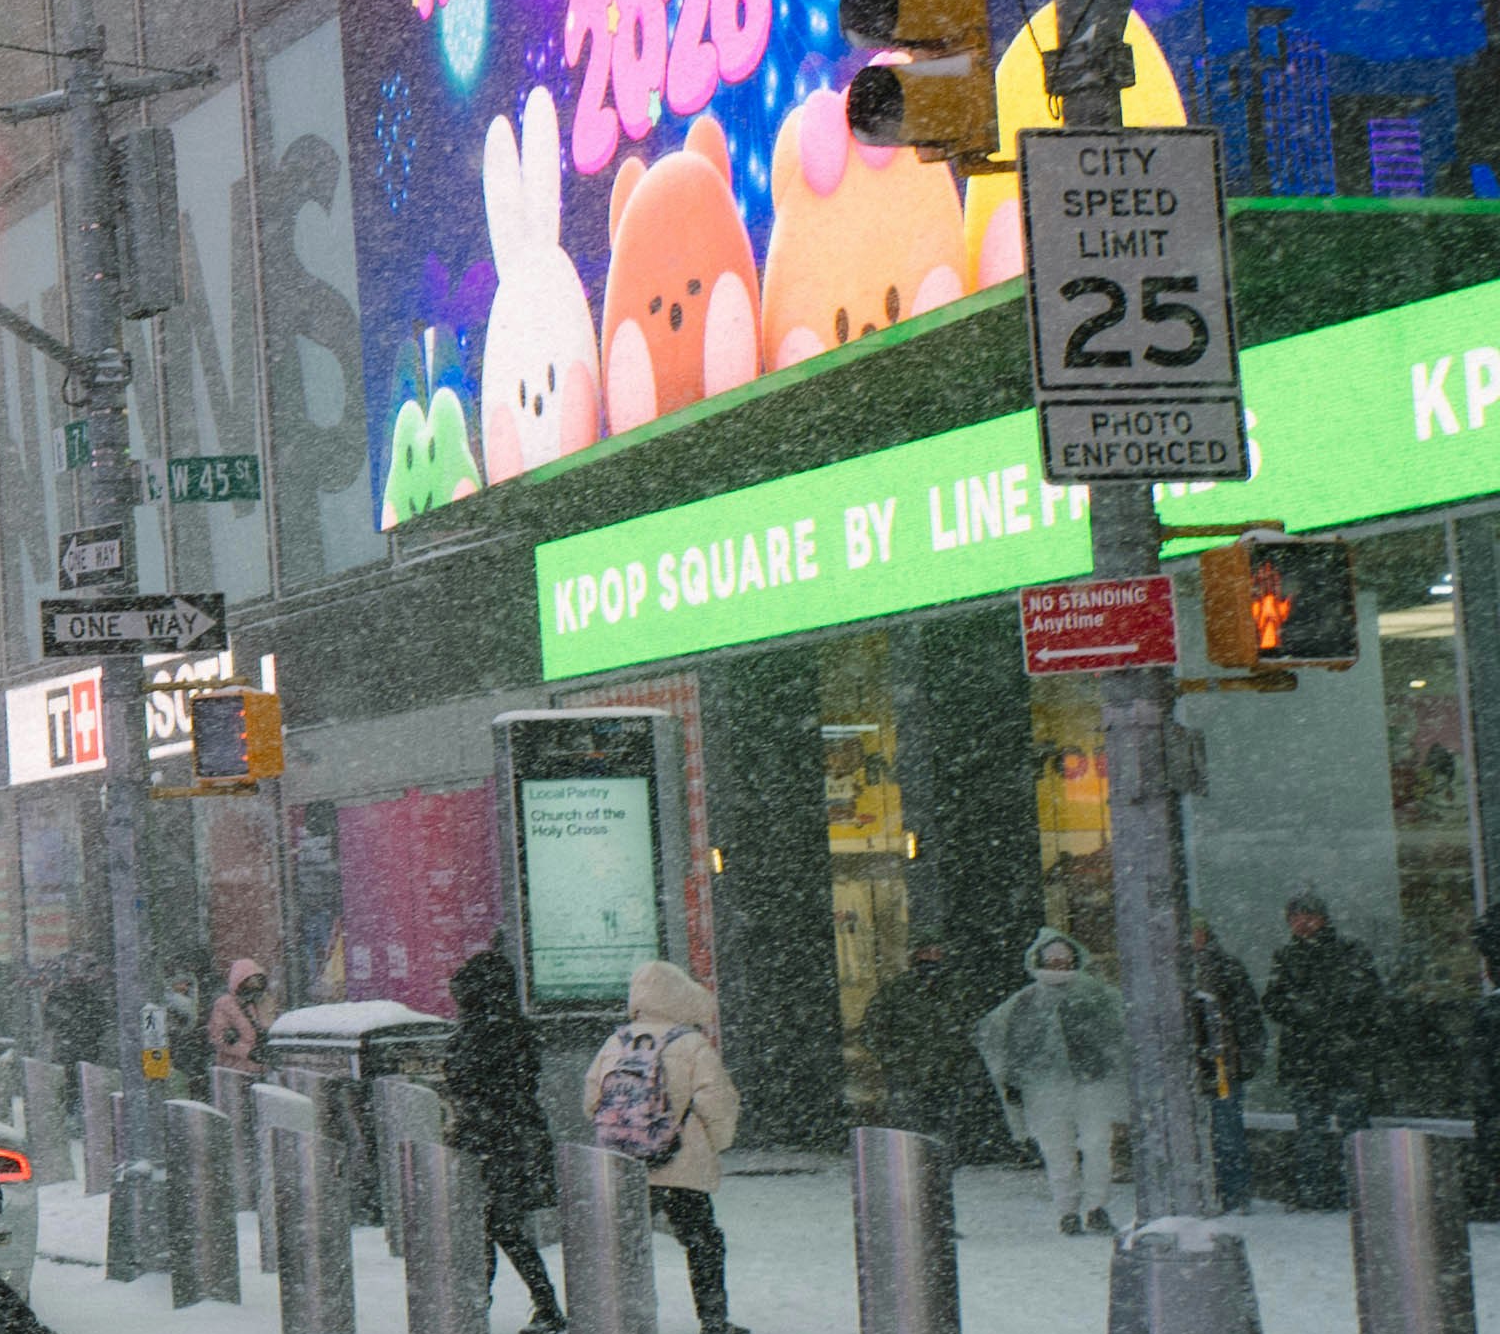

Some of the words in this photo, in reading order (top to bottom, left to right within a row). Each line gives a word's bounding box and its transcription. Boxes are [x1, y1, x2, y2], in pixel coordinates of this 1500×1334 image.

[1078, 147, 1158, 176] CITY
[1062, 187, 1179, 218] SPEED
[1079, 229, 1170, 259] LIMIT
[1059, 275, 1211, 369] 25
[1090, 411, 1193, 437] PHOTO
[1062, 440, 1228, 467] ENFORCED
[171, 463, 189, 499] W
[200, 462, 230, 500] 45
[553, 560, 647, 635] KPOP
[658, 517, 819, 613] SQUARE
[845, 497, 897, 570] BY
[929, 466, 1032, 554] LINE
[1029, 591, 1058, 612] NO
[1062, 585, 1148, 609] STANDING
[69, 615, 122, 639] ONE
[145, 613, 199, 637] WAY
[1032, 609, 1105, 633] Anytime
[529, 786, 565, 800] Local
[566, 786, 610, 801] Pantry
[531, 808, 585, 822] Church
[586, 807, 600, 820] of
[603, 807, 627, 820] the
[531, 824, 563, 840] Holy
[566, 823, 609, 837] Cross
